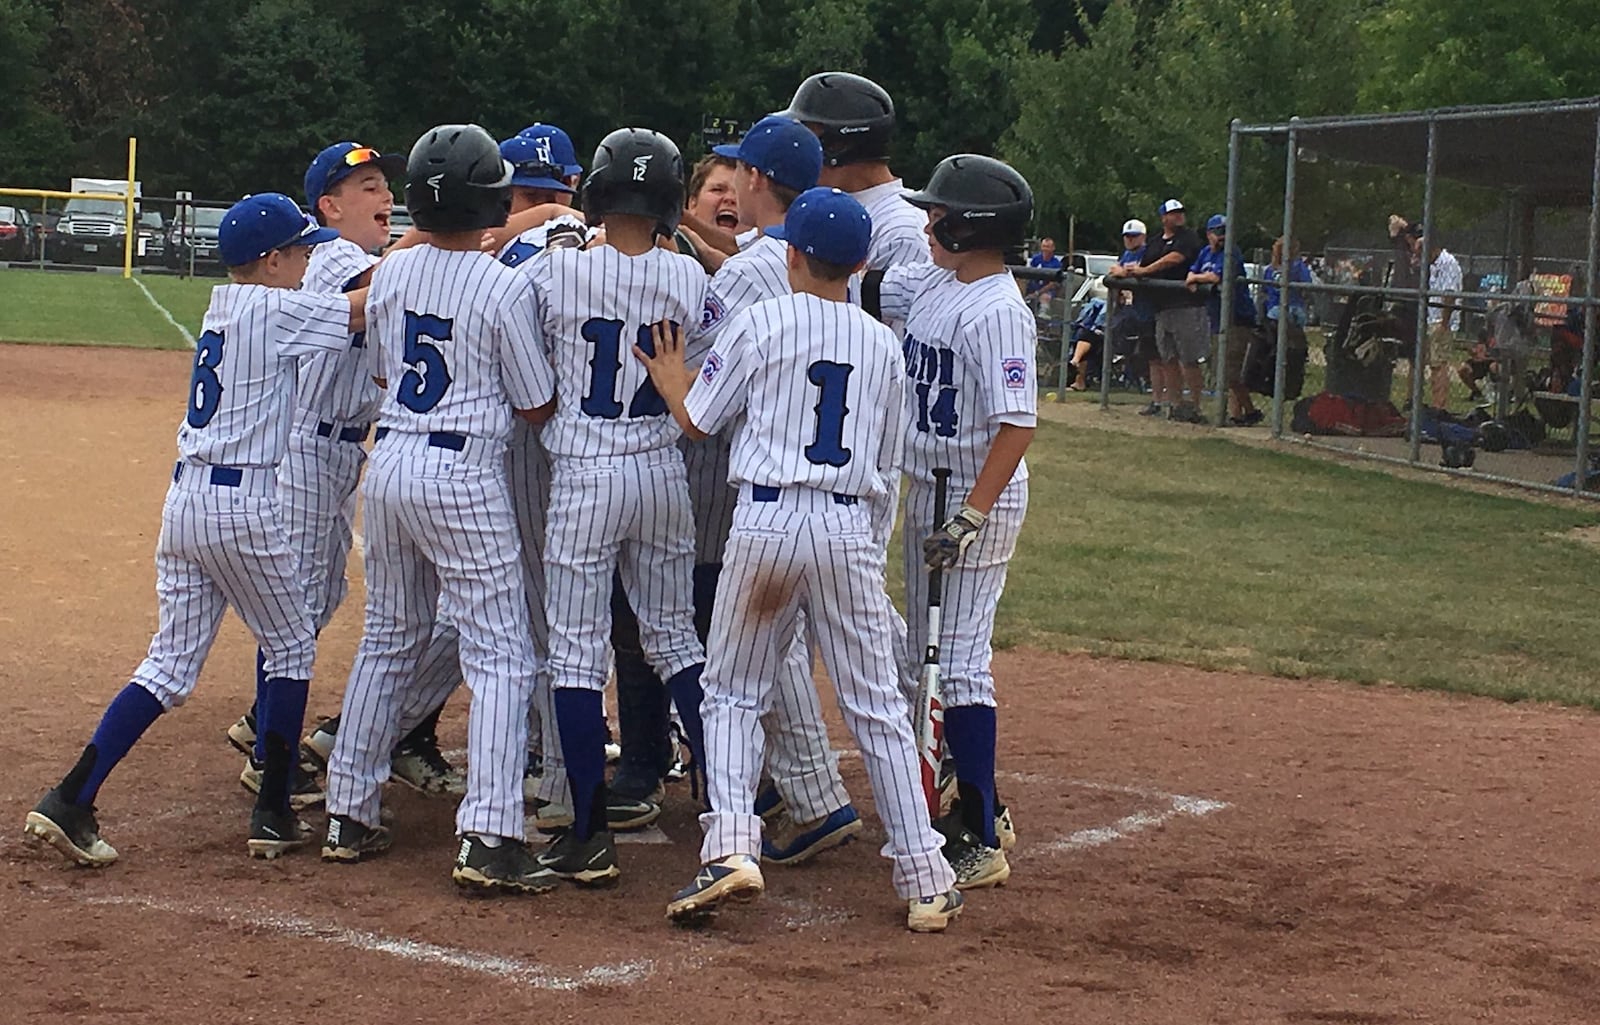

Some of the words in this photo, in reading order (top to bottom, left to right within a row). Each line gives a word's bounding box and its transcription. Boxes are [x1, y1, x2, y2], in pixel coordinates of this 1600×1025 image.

[713, 118, 720, 127] 2
[728, 124, 735, 134] 3
[633, 166, 645, 181] 12
[434, 189, 440, 202] 1
[397, 309, 454, 414] 5
[804, 359, 855, 468] 1
[915, 382, 959, 438] 14
[327, 817, 342, 845] NIKE
[456, 838, 472, 866] NIKE
